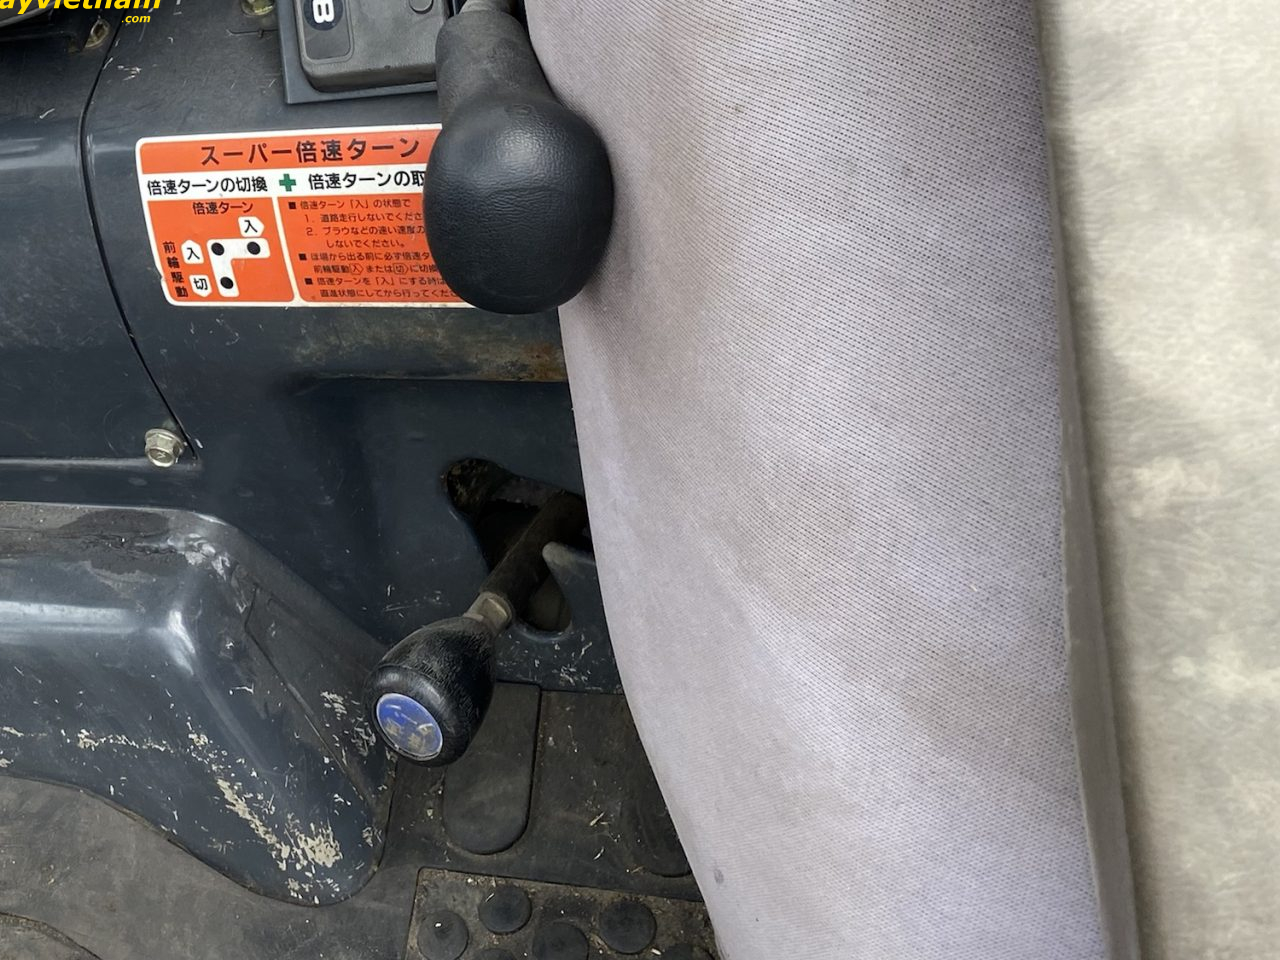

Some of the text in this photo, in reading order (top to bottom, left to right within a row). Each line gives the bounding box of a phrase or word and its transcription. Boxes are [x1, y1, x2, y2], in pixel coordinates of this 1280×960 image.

[200, 137, 420, 167] スーパー倍速ターン
[146, 175, 268, 196] 倍速ターンの切換
[192, 201, 253, 215] 倍速ターン
[244, 219, 259, 234] 入
[326, 239, 405, 249] しないでください。
[186, 247, 200, 261] 入
[162, 240, 189, 298] 前輪駆動
[193, 277, 208, 291] 切
